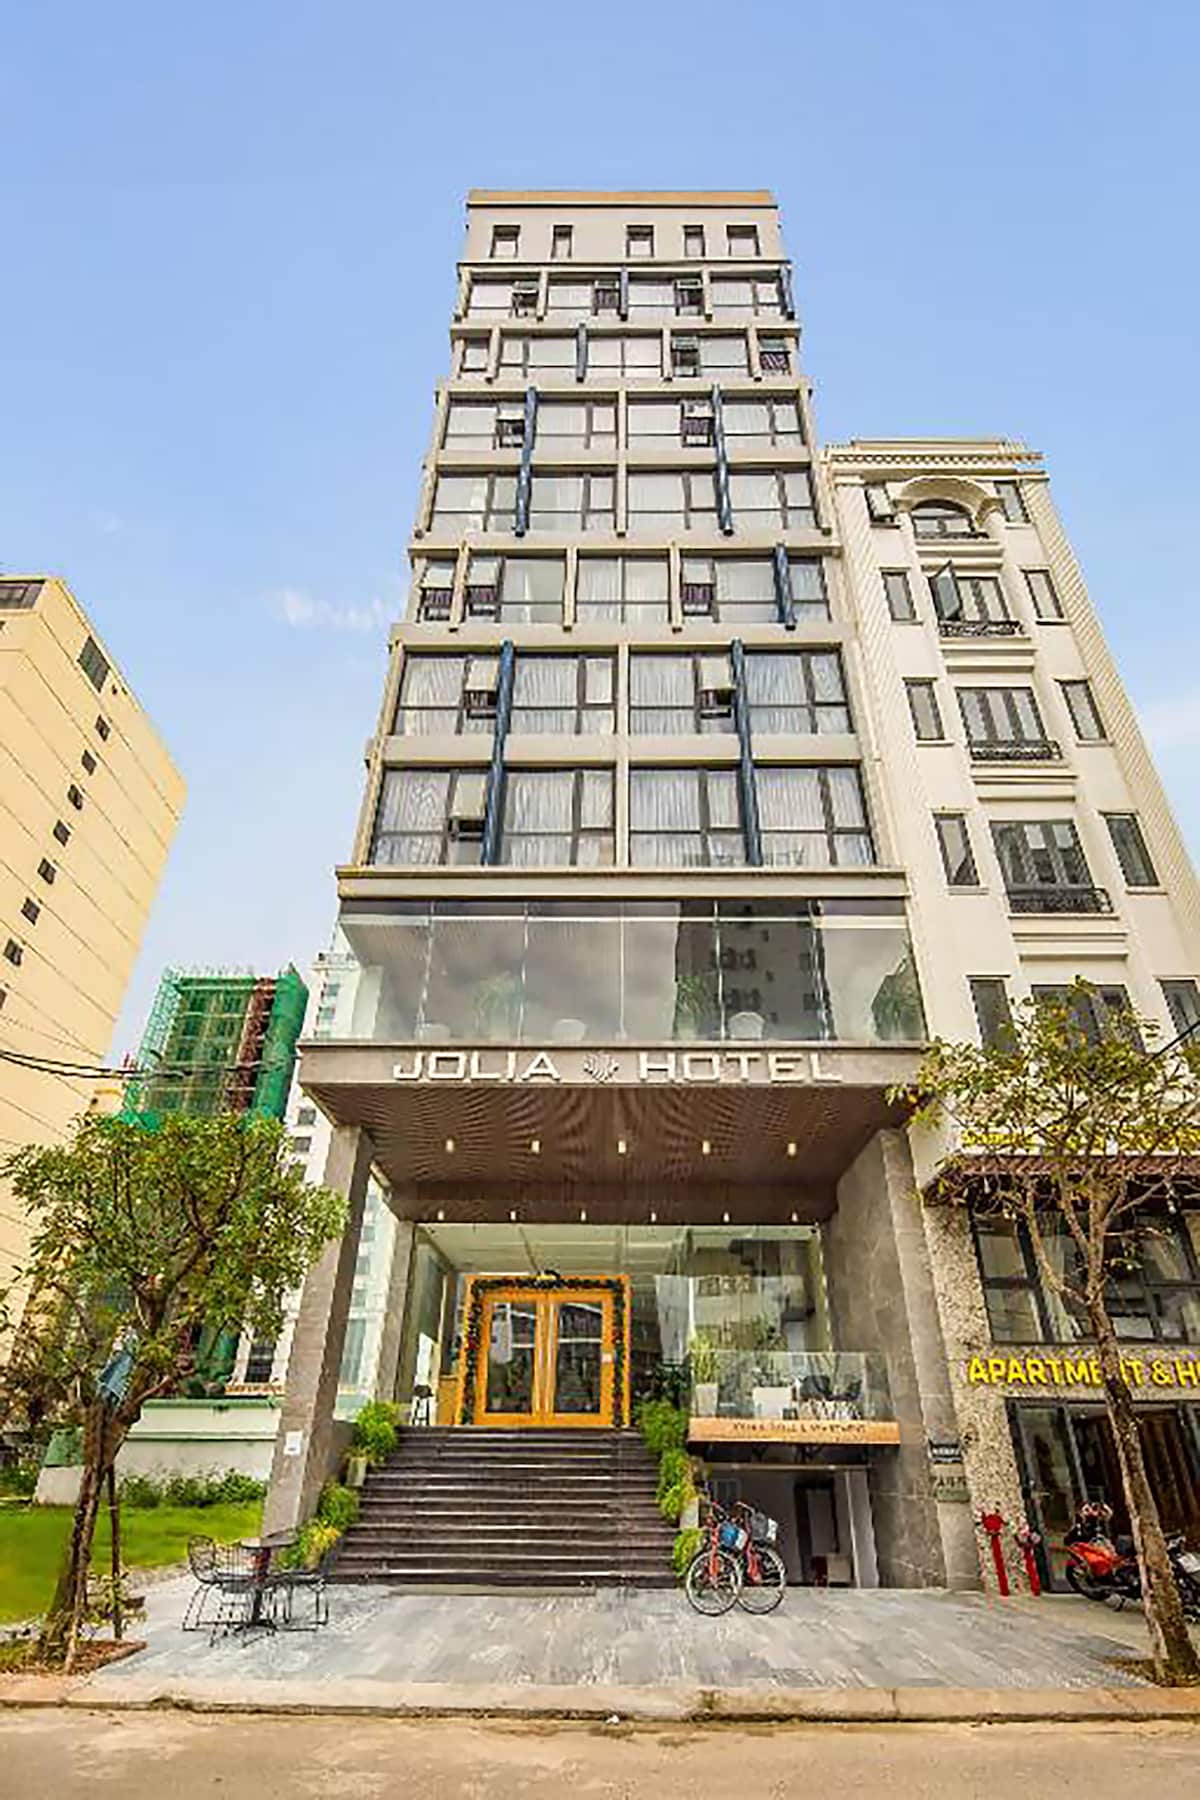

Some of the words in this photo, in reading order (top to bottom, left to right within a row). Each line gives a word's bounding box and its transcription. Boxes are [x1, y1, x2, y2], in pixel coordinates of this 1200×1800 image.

[393, 1050, 561, 1083] JOLIA
[639, 1050, 843, 1083] HOTEL
[968, 1358, 1146, 1387] APARTMET
[1151, 1360, 1172, 1386] &
[1175, 1359, 1200, 1388] H
